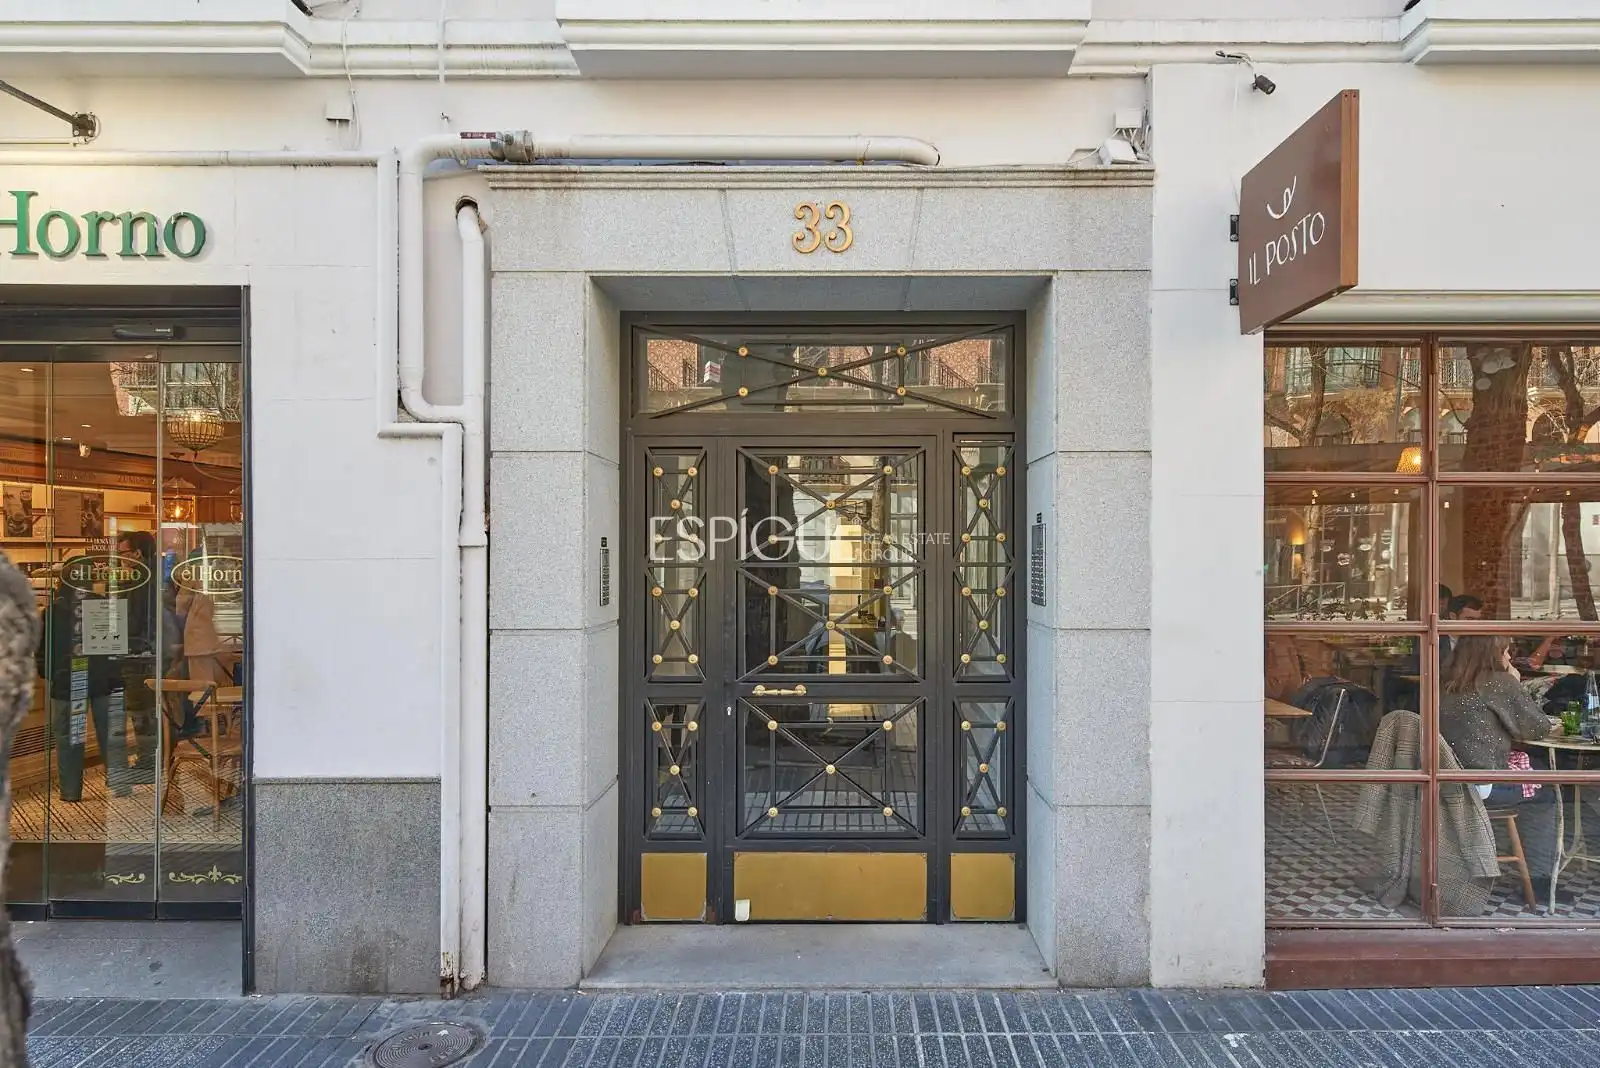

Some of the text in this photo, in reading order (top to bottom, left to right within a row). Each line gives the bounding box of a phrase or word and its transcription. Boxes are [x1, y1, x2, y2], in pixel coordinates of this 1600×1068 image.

[0, 190, 206, 258] Horno
[792, 200, 853, 254] 33
[1248, 211, 1325, 285] IL POSTO
[69, 564, 141, 581] el Horno
[181, 564, 196, 581] el
